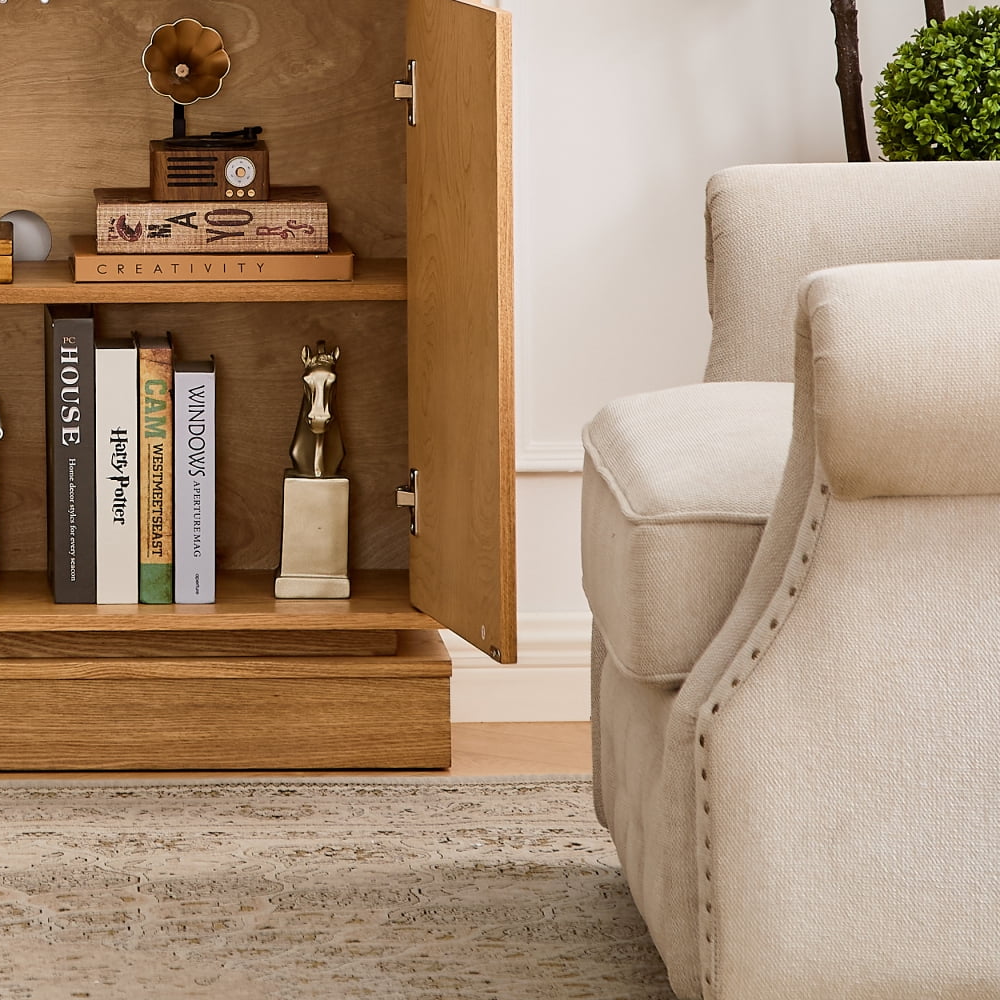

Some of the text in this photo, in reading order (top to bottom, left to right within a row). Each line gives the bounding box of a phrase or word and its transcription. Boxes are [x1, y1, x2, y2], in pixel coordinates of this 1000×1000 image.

[97, 262, 265, 275] CREATIVITY
[61, 346, 80, 446] HOUSE
[144, 380, 168, 439] CAM
[188, 384, 206, 477] WINDOWS
[68, 458, 77, 481] Home
[106, 426, 130, 526] Harry Potter
[68, 482, 77, 503] decor
[69, 525, 78, 536] for
[193, 481, 202, 558] APERTURE MAG
[68, 537, 77, 556] every
